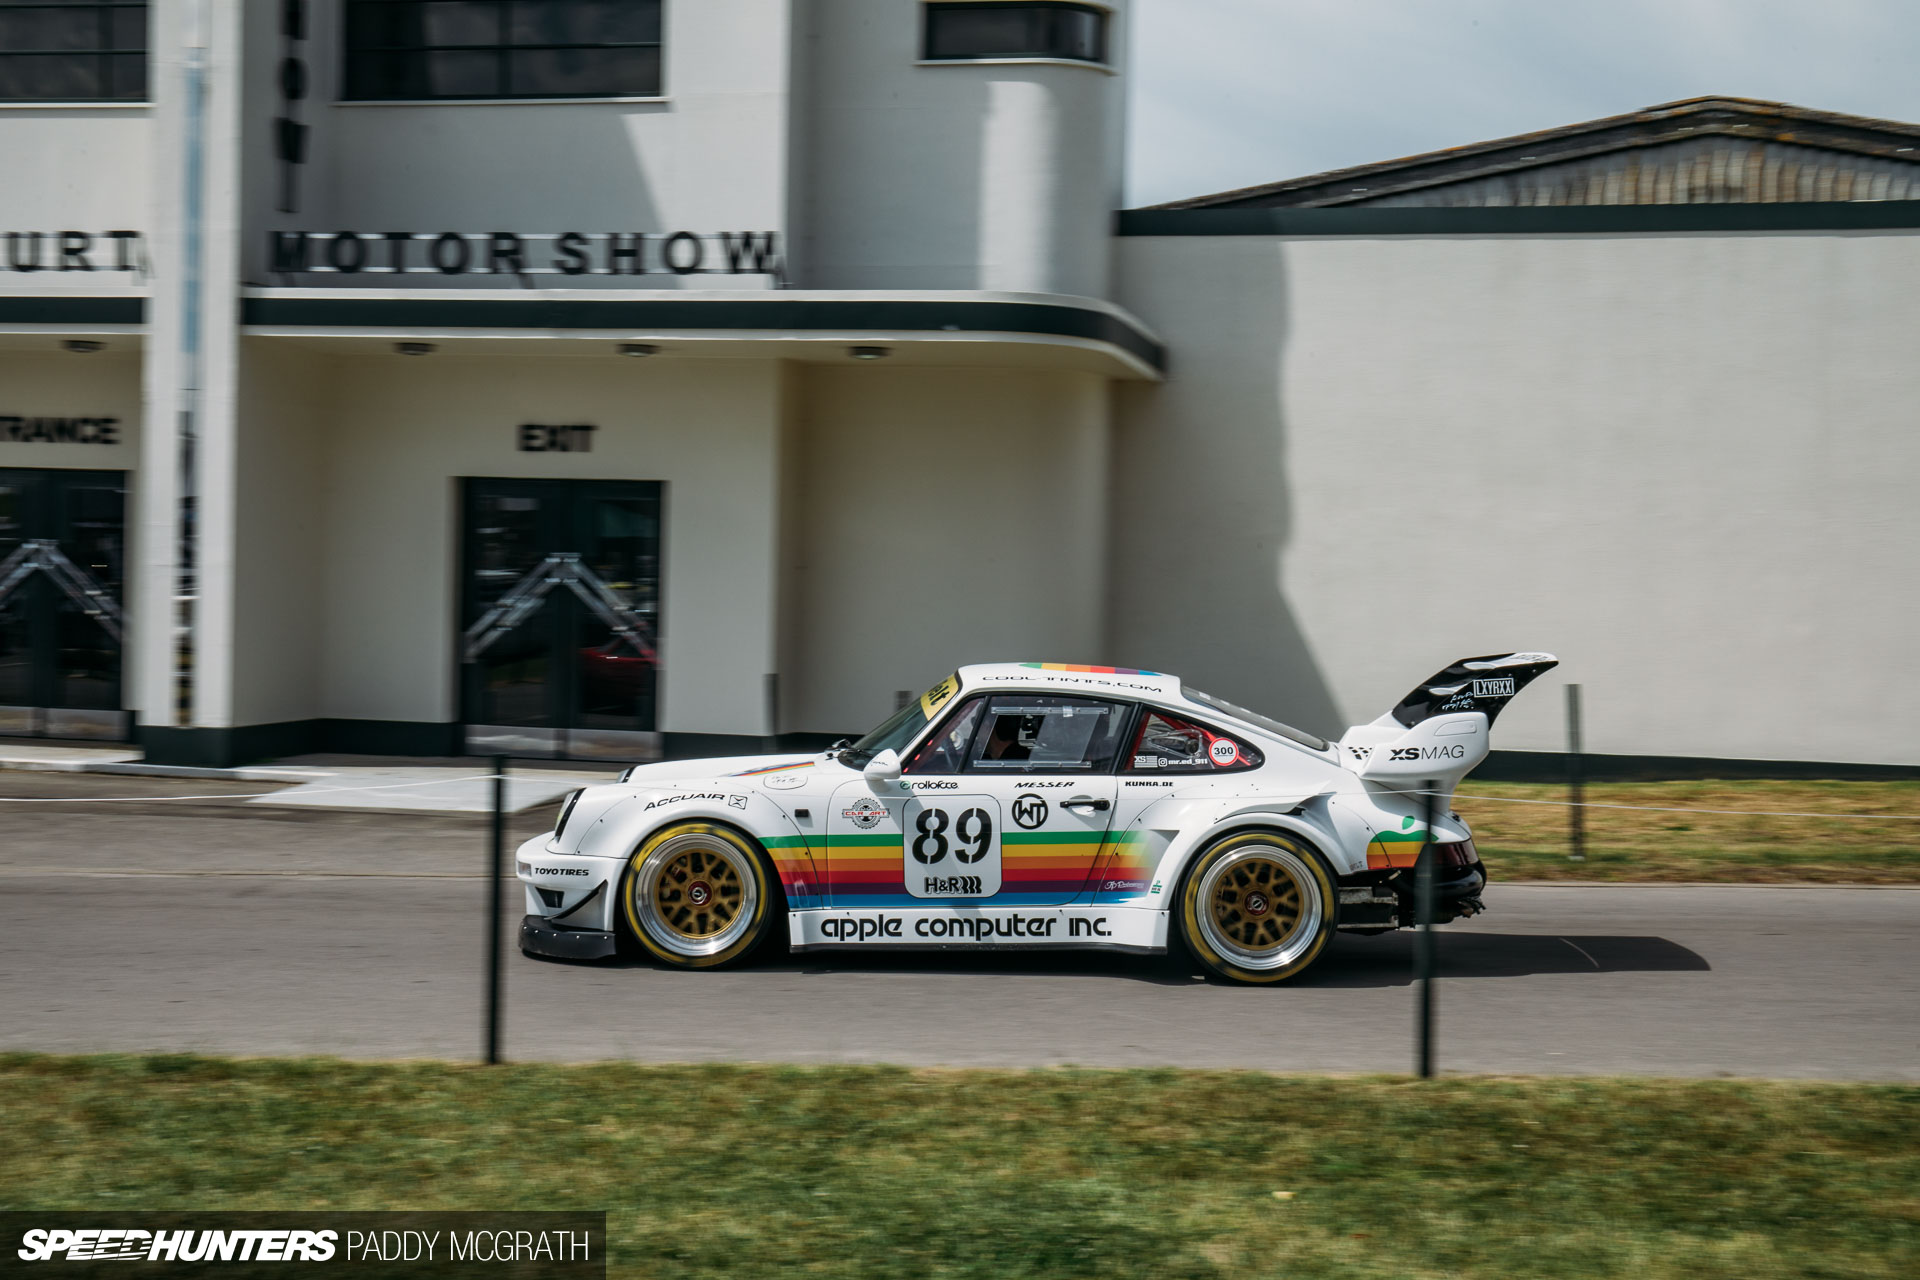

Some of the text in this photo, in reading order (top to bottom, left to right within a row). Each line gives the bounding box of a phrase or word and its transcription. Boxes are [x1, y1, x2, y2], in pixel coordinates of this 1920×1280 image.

[268, 230, 526, 275] MOTOR
[553, 230, 778, 275] SHOW
[516, 424, 600, 452] EXIT
[1476, 679, 1512, 695] LXYRXX
[1214, 747, 1234, 755] 300
[644, 793, 726, 811] ACCUAIR
[911, 807, 993, 865] 89
[535, 867, 589, 876] TOYO TIRES
[925, 876, 960, 893] H&R
[821, 912, 1112, 941] apple computer inc.
